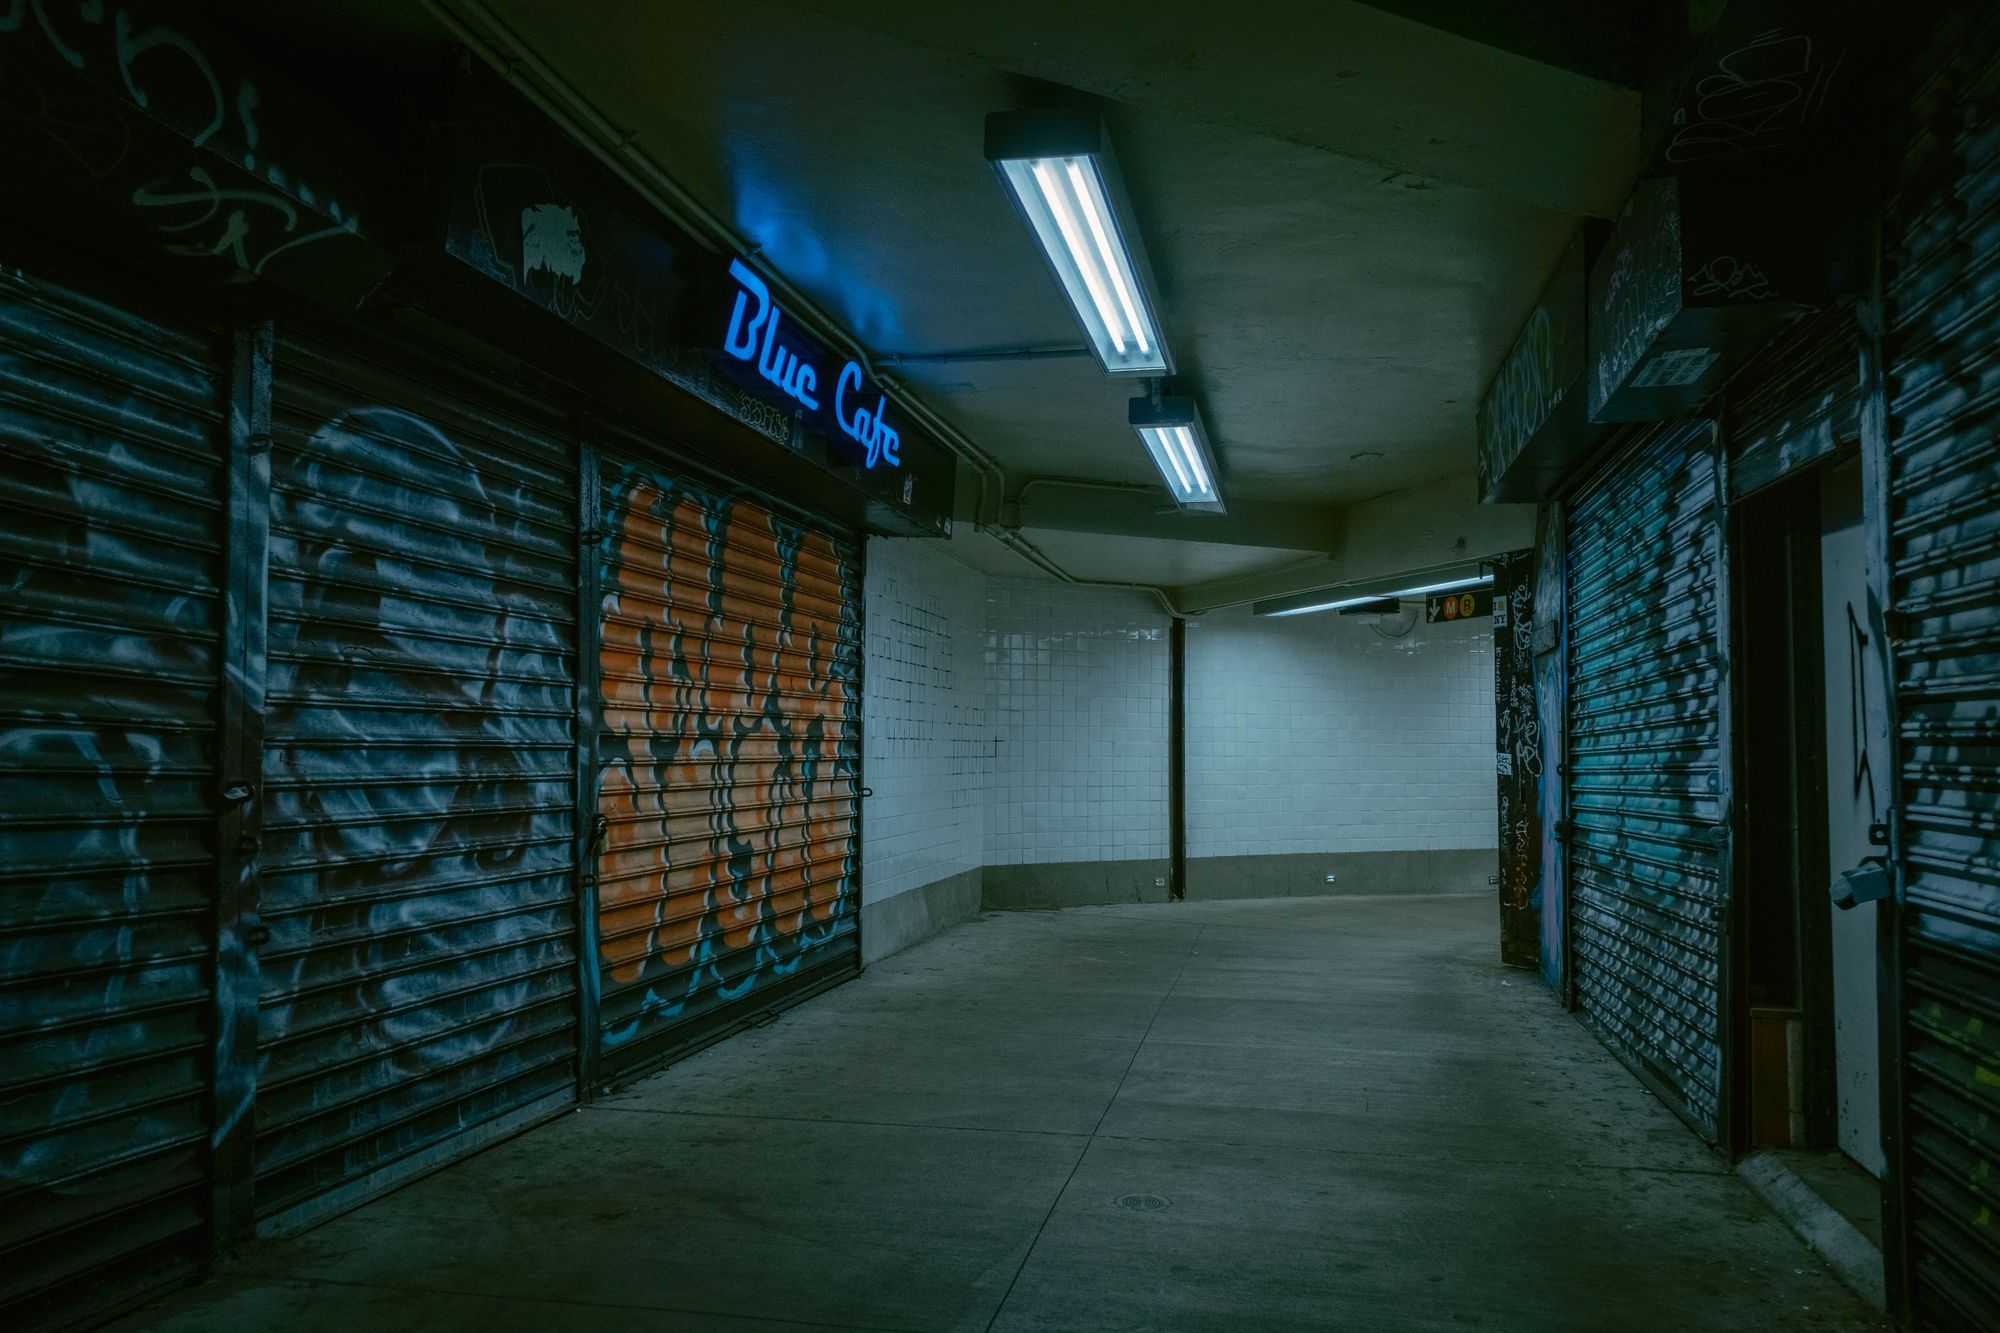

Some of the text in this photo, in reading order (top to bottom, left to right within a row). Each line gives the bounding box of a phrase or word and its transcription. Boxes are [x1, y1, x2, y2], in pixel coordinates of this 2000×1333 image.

[724, 257, 819, 410] Blue
[835, 361, 901, 469] Cafe
[1494, 615, 1505, 624] NY
